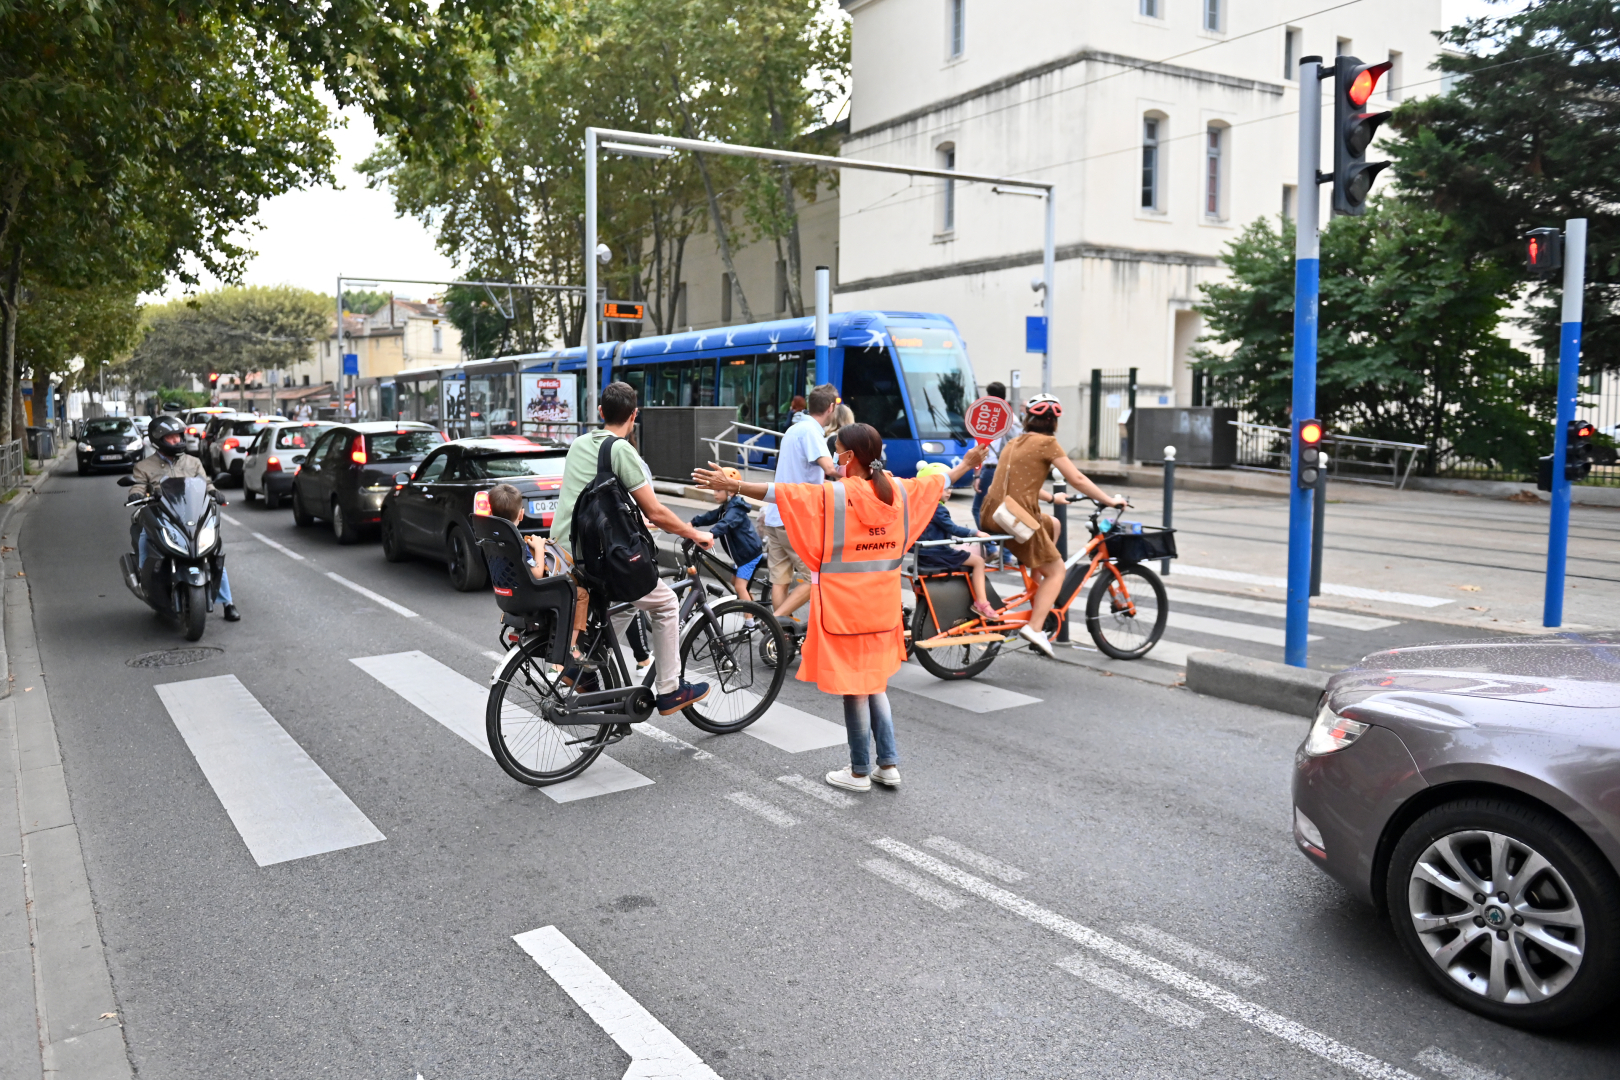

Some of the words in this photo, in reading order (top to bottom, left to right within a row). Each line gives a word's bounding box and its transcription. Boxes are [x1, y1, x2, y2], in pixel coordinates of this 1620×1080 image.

[975, 404, 992, 432] STOP
[869, 527, 886, 536] SES
[855, 541, 896, 551] ENFANTS
